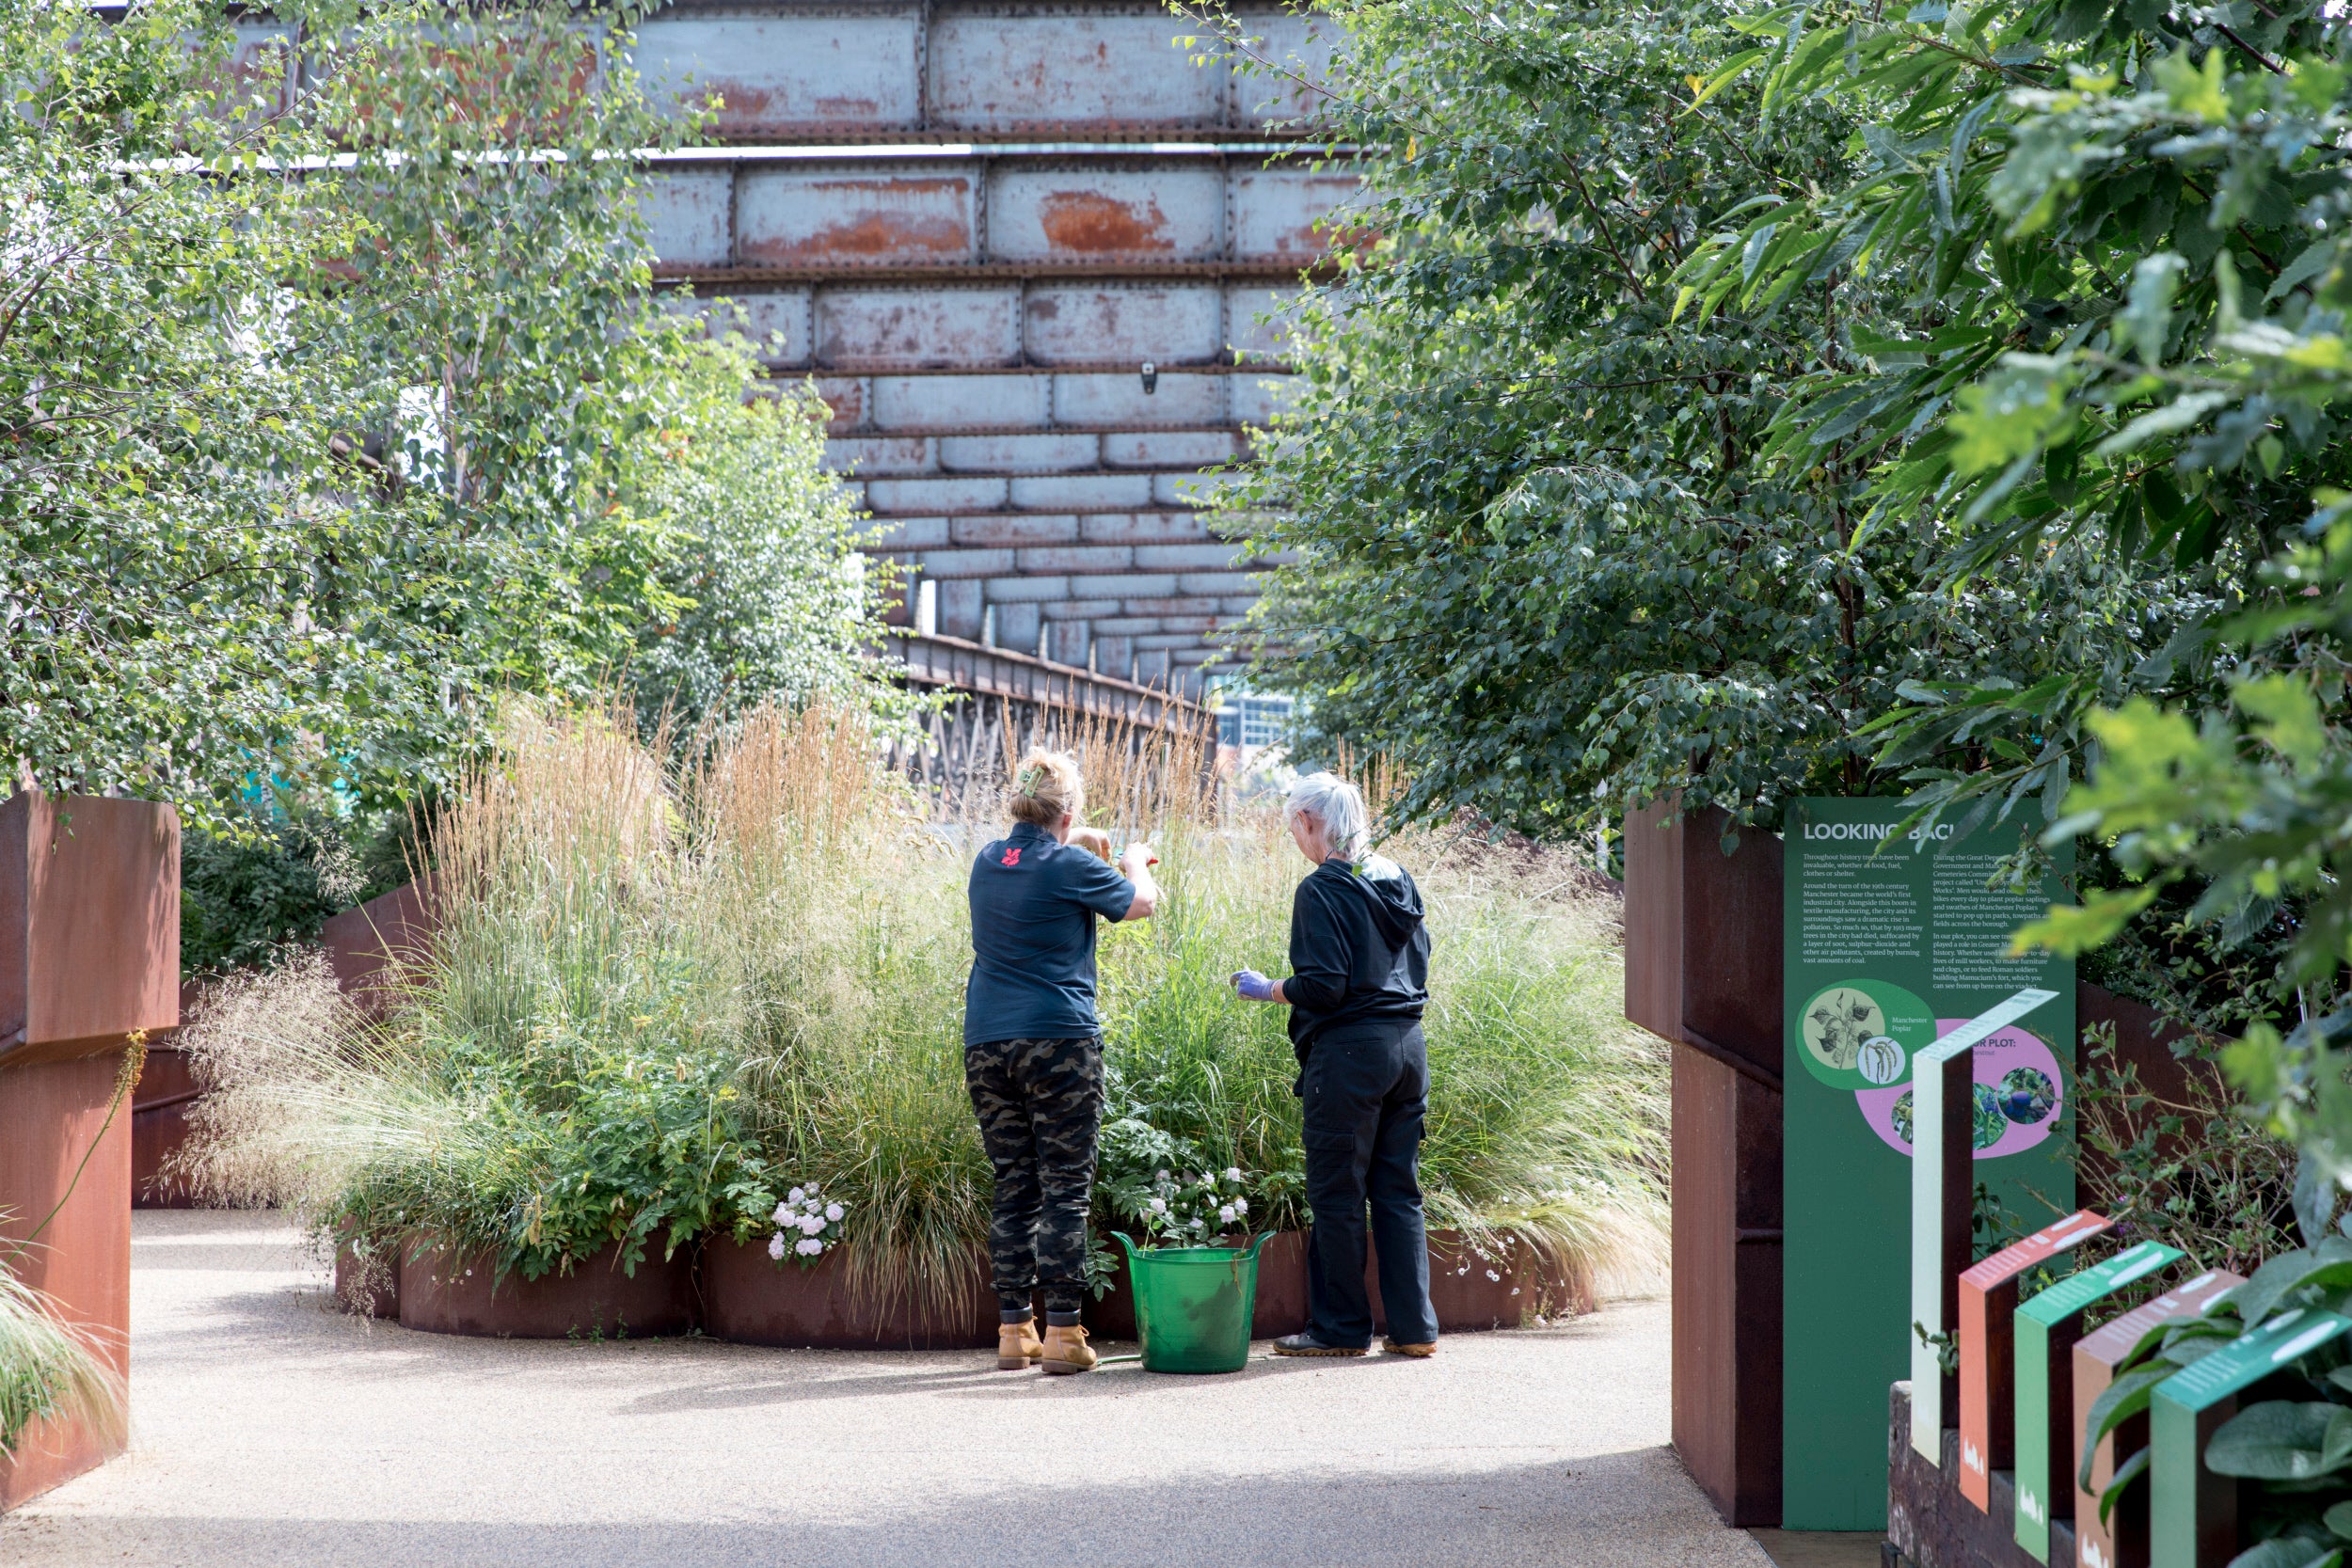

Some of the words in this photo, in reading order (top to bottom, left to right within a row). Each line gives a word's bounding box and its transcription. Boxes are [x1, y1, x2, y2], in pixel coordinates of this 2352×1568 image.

[1803, 853, 1839, 862] Throughout
[1840, 853, 1861, 862] history
[1803, 862, 1836, 870] invaluable,
[1871, 862, 1887, 870] food,
[1888, 862, 1902, 870] fuel,
[1886, 882, 1910, 890] century
[1933, 879, 1954, 887] project
[1834, 899, 1846, 907] city.
[1847, 899, 1877, 907] Alongside
[1968, 895, 1979, 903] day
[1988, 895, 2003, 903] plant
[2004, 895, 2024, 903] poplar
[2025, 895, 2051, 903] saplings
[1824, 907, 1871, 915] manufacturing,
[1883, 907, 1895, 915] city
[2015, 903, 2038, 912] Poplars
[1993, 912, 2011, 920] parks,
[2013, 912, 2041, 920] towpaths
[1803, 923, 1832, 932] pollution.
[1884, 923, 1892, 932] by
[1982, 920, 2009, 928] borough.
[1838, 932, 1850, 940] city
[1863, 932, 1878, 940] died,
[1912, 932, 1920, 940] by
[1952, 932, 1965, 940] plot,
[1808, 940, 1823, 948] layer
[1832, 940, 1847, 948] soot,
[1933, 940, 1952, 949] played
[1830, 948, 1862, 957] pollutants,
[1887, 948, 1894, 957] by
[1895, 948, 1920, 957] burning
[1933, 949, 1955, 957] history.
[1969, 957, 1994, 965] workers,
[1945, 965, 1962, 974] clogs,
[1933, 974, 1958, 982] building
[1998, 974, 2010, 982] fort,
[1988, 1038, 2016, 1047] PLOT:
